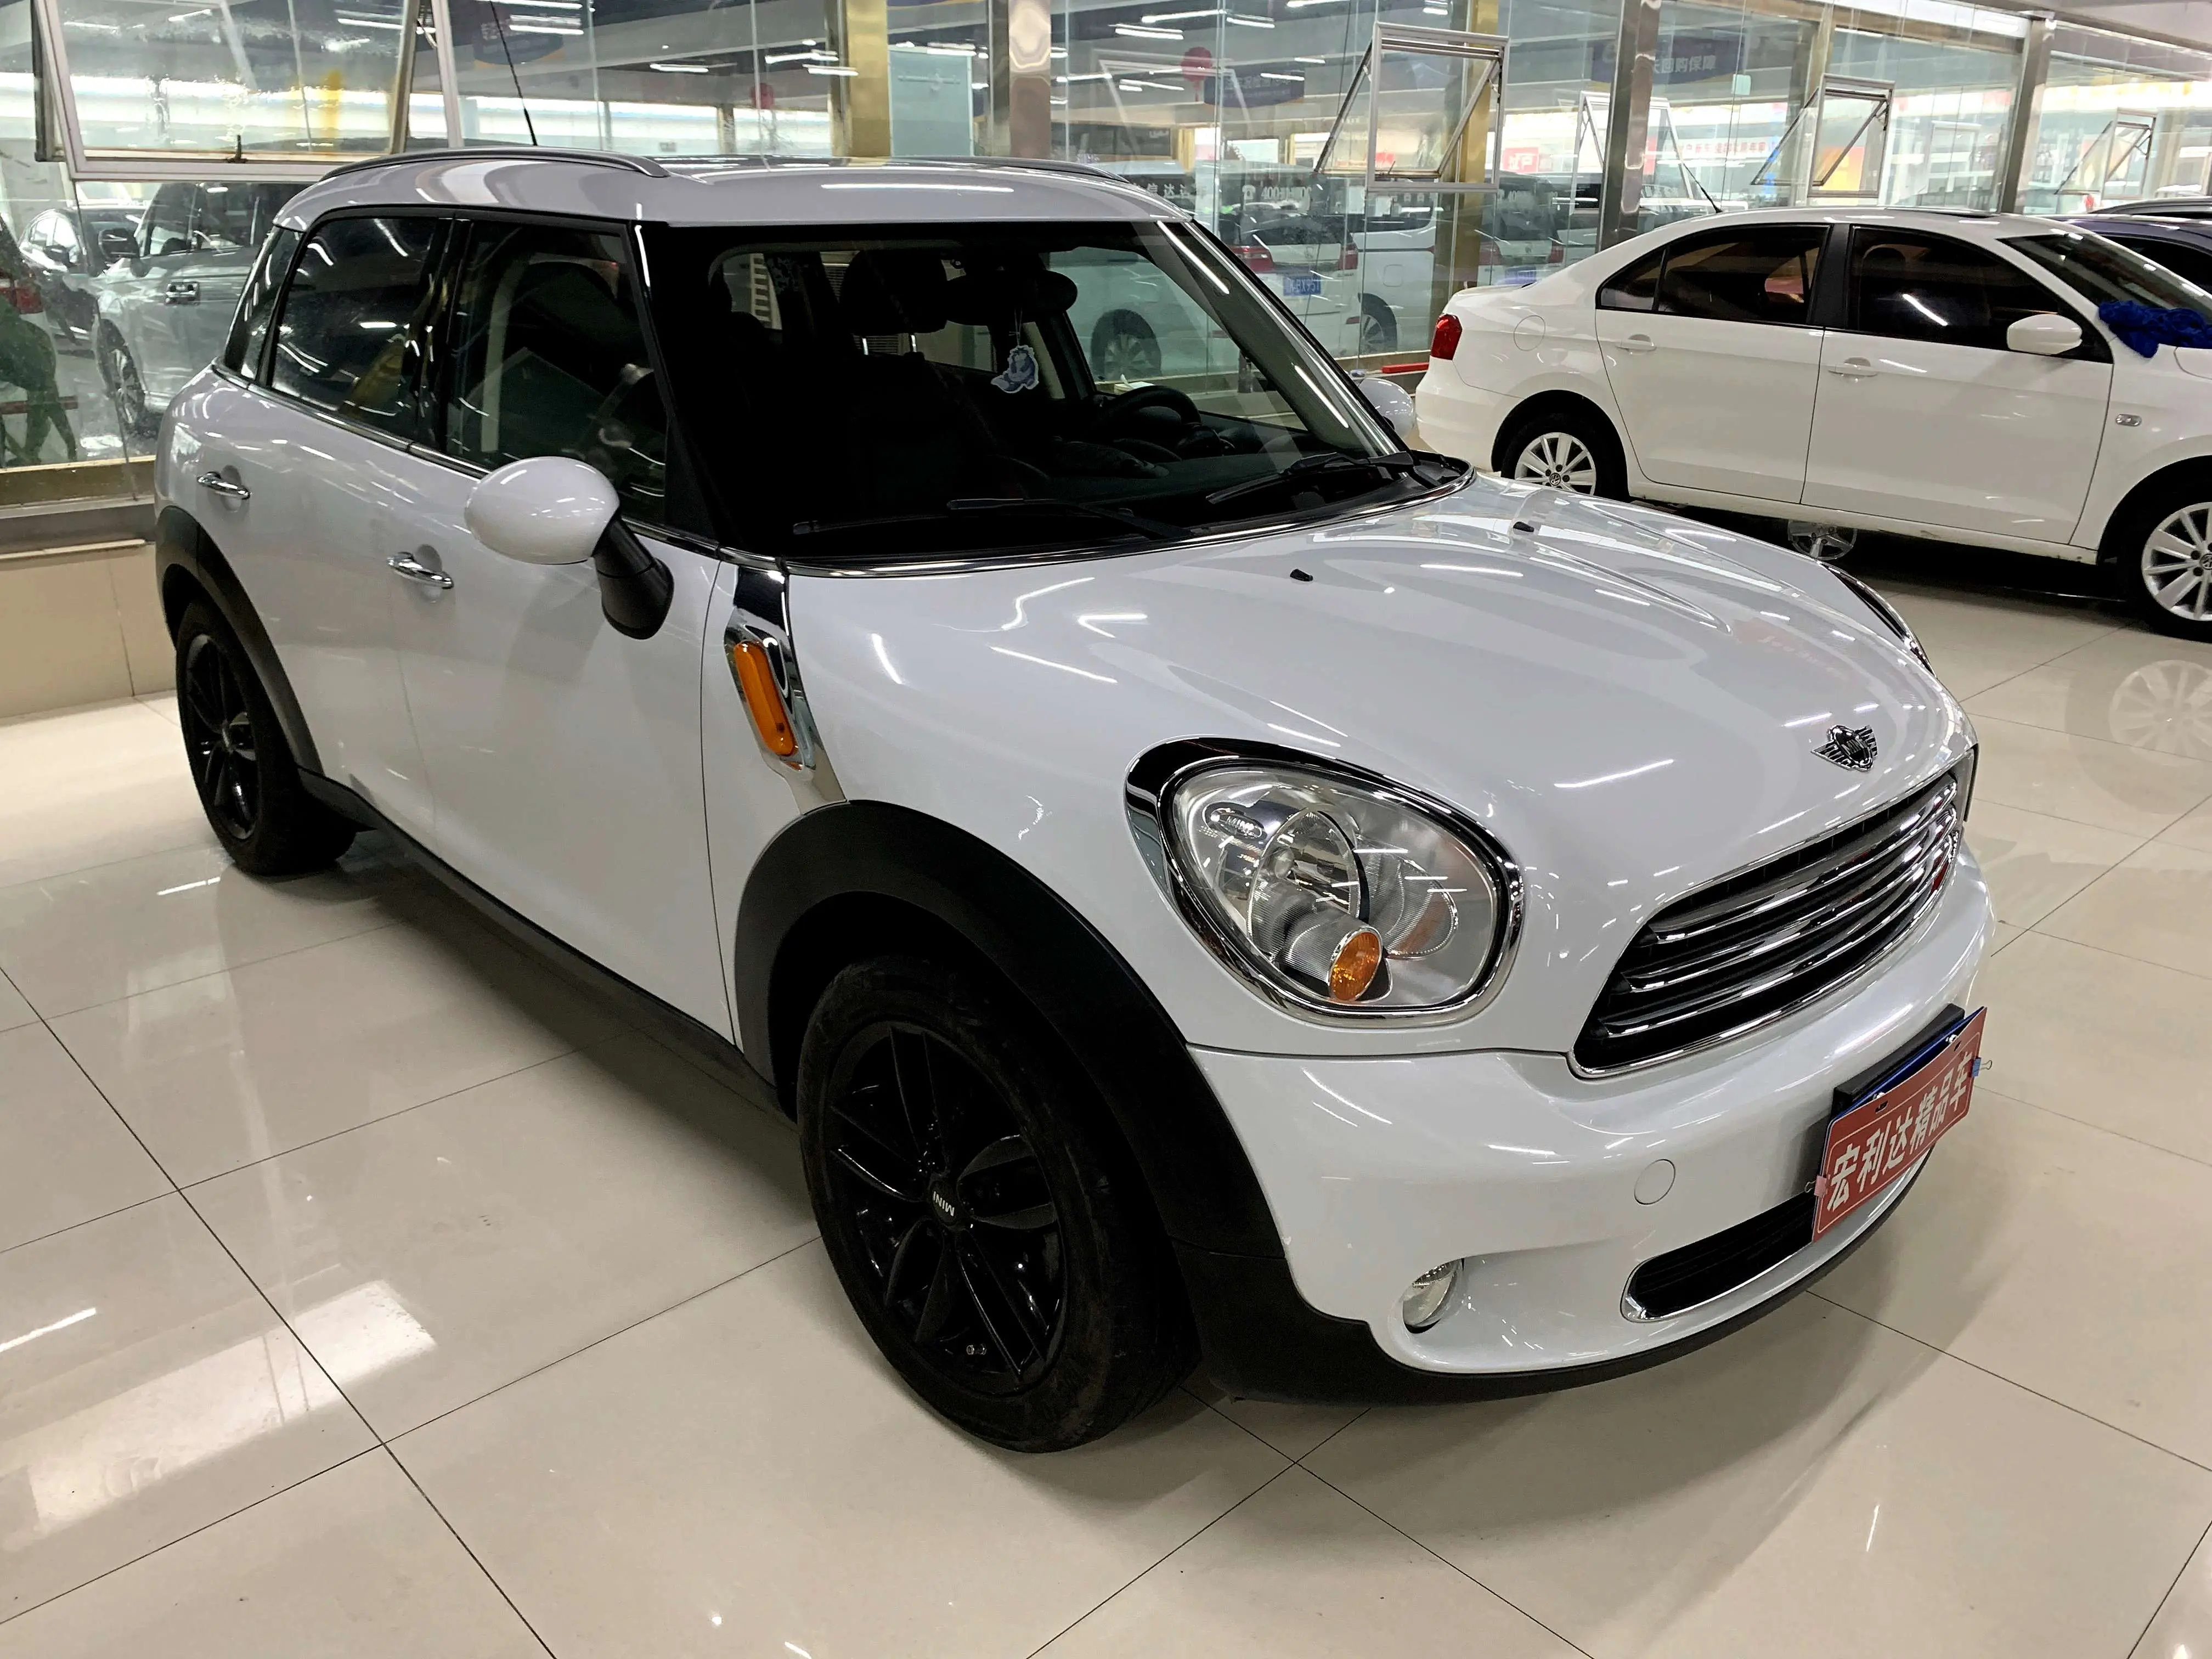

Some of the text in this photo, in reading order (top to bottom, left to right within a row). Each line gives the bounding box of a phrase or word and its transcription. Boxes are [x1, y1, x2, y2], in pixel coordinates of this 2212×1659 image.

[1827, 1051, 1972, 1212] 宏利达精品车
[933, 1190, 955, 1216] MINI
